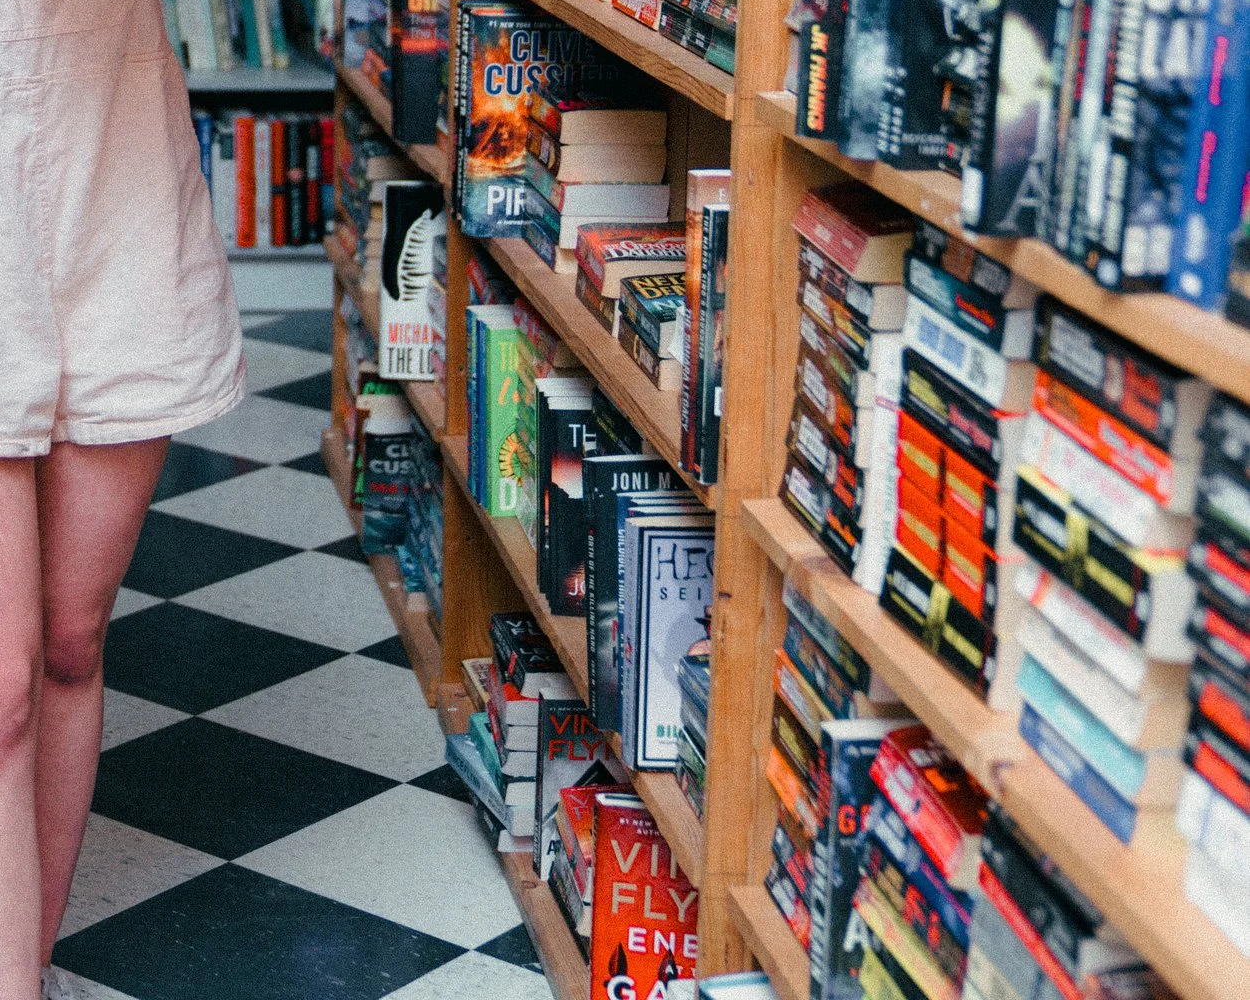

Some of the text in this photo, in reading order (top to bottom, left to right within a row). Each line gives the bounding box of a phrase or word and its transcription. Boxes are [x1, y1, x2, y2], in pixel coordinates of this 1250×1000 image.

[461, 13, 471, 49] CLIVE
[499, 21, 514, 29] NEW
[810, 24, 829, 52] JK
[509, 29, 595, 63] CLIVE
[459, 54, 469, 117] CUSSLER
[701, 237, 709, 270] MARSH
[698, 309, 706, 360] DAUGHTER
[387, 347, 413, 375] THE
[680, 308, 692, 432] THE SAHARA LEGACY
[610, 472, 679, 491] JONI M.
[632, 818, 653, 829] NEW
